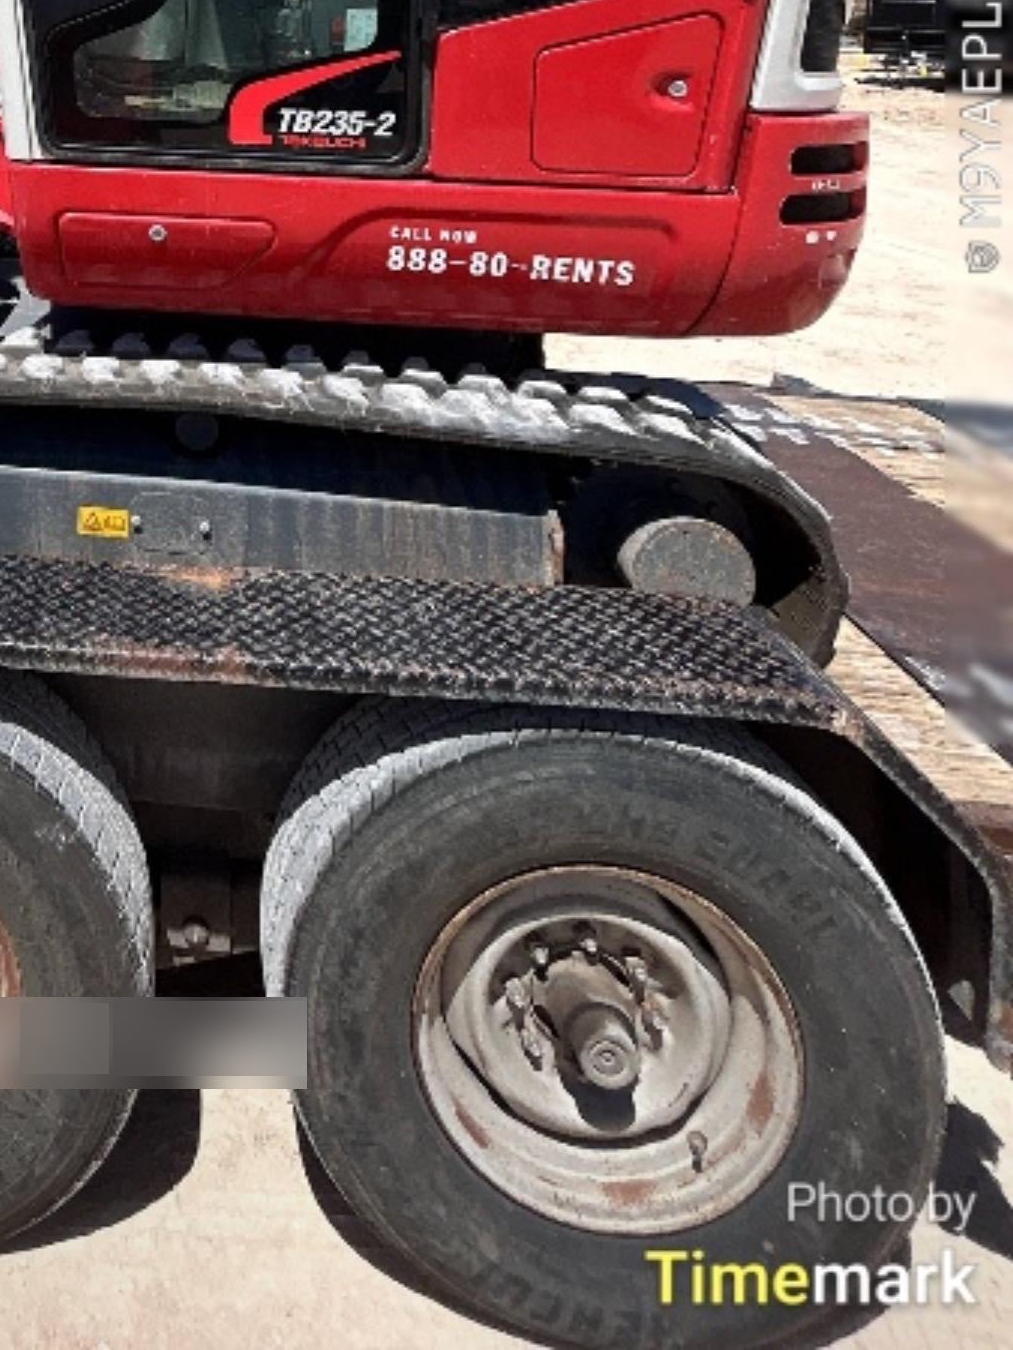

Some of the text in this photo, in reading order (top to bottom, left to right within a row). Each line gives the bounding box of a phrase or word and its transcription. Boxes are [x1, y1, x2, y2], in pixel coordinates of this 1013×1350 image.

[279, 107, 396, 137] TB235-2
[389, 226, 477, 244] CALL NOW
[386, 246, 635, 286] 888-80-RENTS
